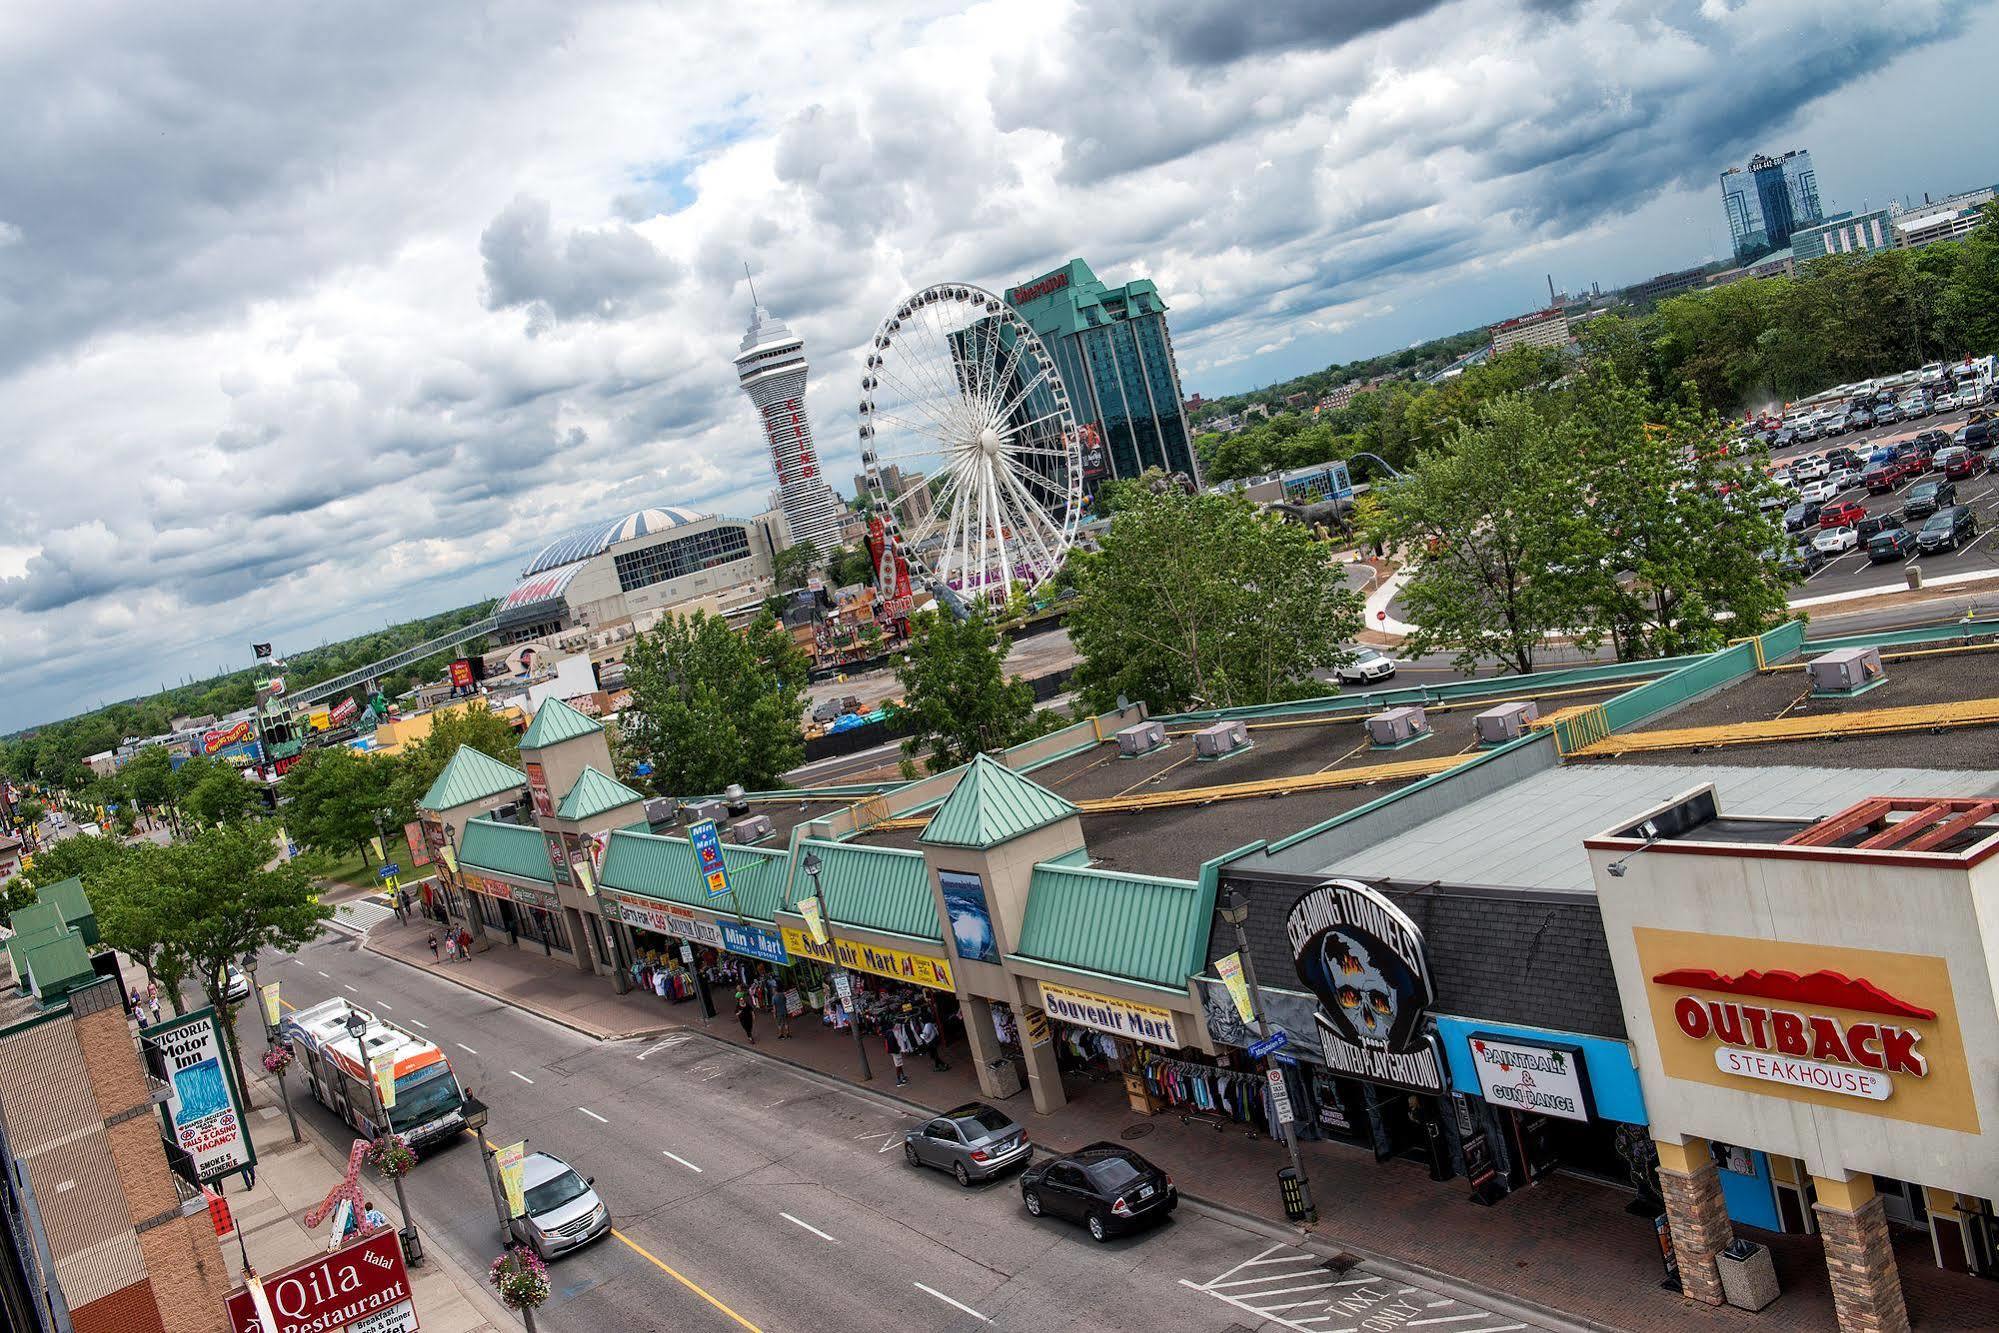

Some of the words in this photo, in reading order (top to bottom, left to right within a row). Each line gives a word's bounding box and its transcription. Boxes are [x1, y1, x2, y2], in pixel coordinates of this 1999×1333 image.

[1013, 273, 1069, 305] Sheraton
[758, 934, 782, 956] Mart
[1287, 887, 1342, 960] SCREAMING
[1335, 888, 1420, 977] TUNNELS
[802, 933, 858, 966] Souvnir
[863, 947, 899, 975] Mart
[1045, 992, 1123, 1030] Souvenir
[1126, 1010, 1176, 1043] Mart
[152, 1020, 211, 1046] VICTORIA
[161, 1034, 209, 1058] Motor
[1673, 995, 1930, 1079] OUTBACK
[174, 1052, 203, 1070] Inn
[1318, 1024, 1364, 1075] HAUNTED
[1360, 1047, 1440, 1089] PLAYGROUND
[1483, 1047, 1567, 1076] PAINTBALL
[1521, 1069, 1537, 1088] &
[1492, 1083, 1524, 1104] GUN
[1525, 1089, 1575, 1113] RANGE
[183, 1136, 203, 1150] FALLS
[210, 1123, 237, 1139] CASINO
[196, 1131, 237, 1153] VACANCY
[363, 1250, 395, 1270] Halal
[275, 1262, 363, 1320] Qila
[1323, 1286, 1391, 1318] TAXI
[283, 1279, 405, 1333] Restaurant
[356, 1308, 395, 1330] Breakfast
[384, 1309, 412, 1327] Dinner
[1361, 1298, 1423, 1333] ONLY
